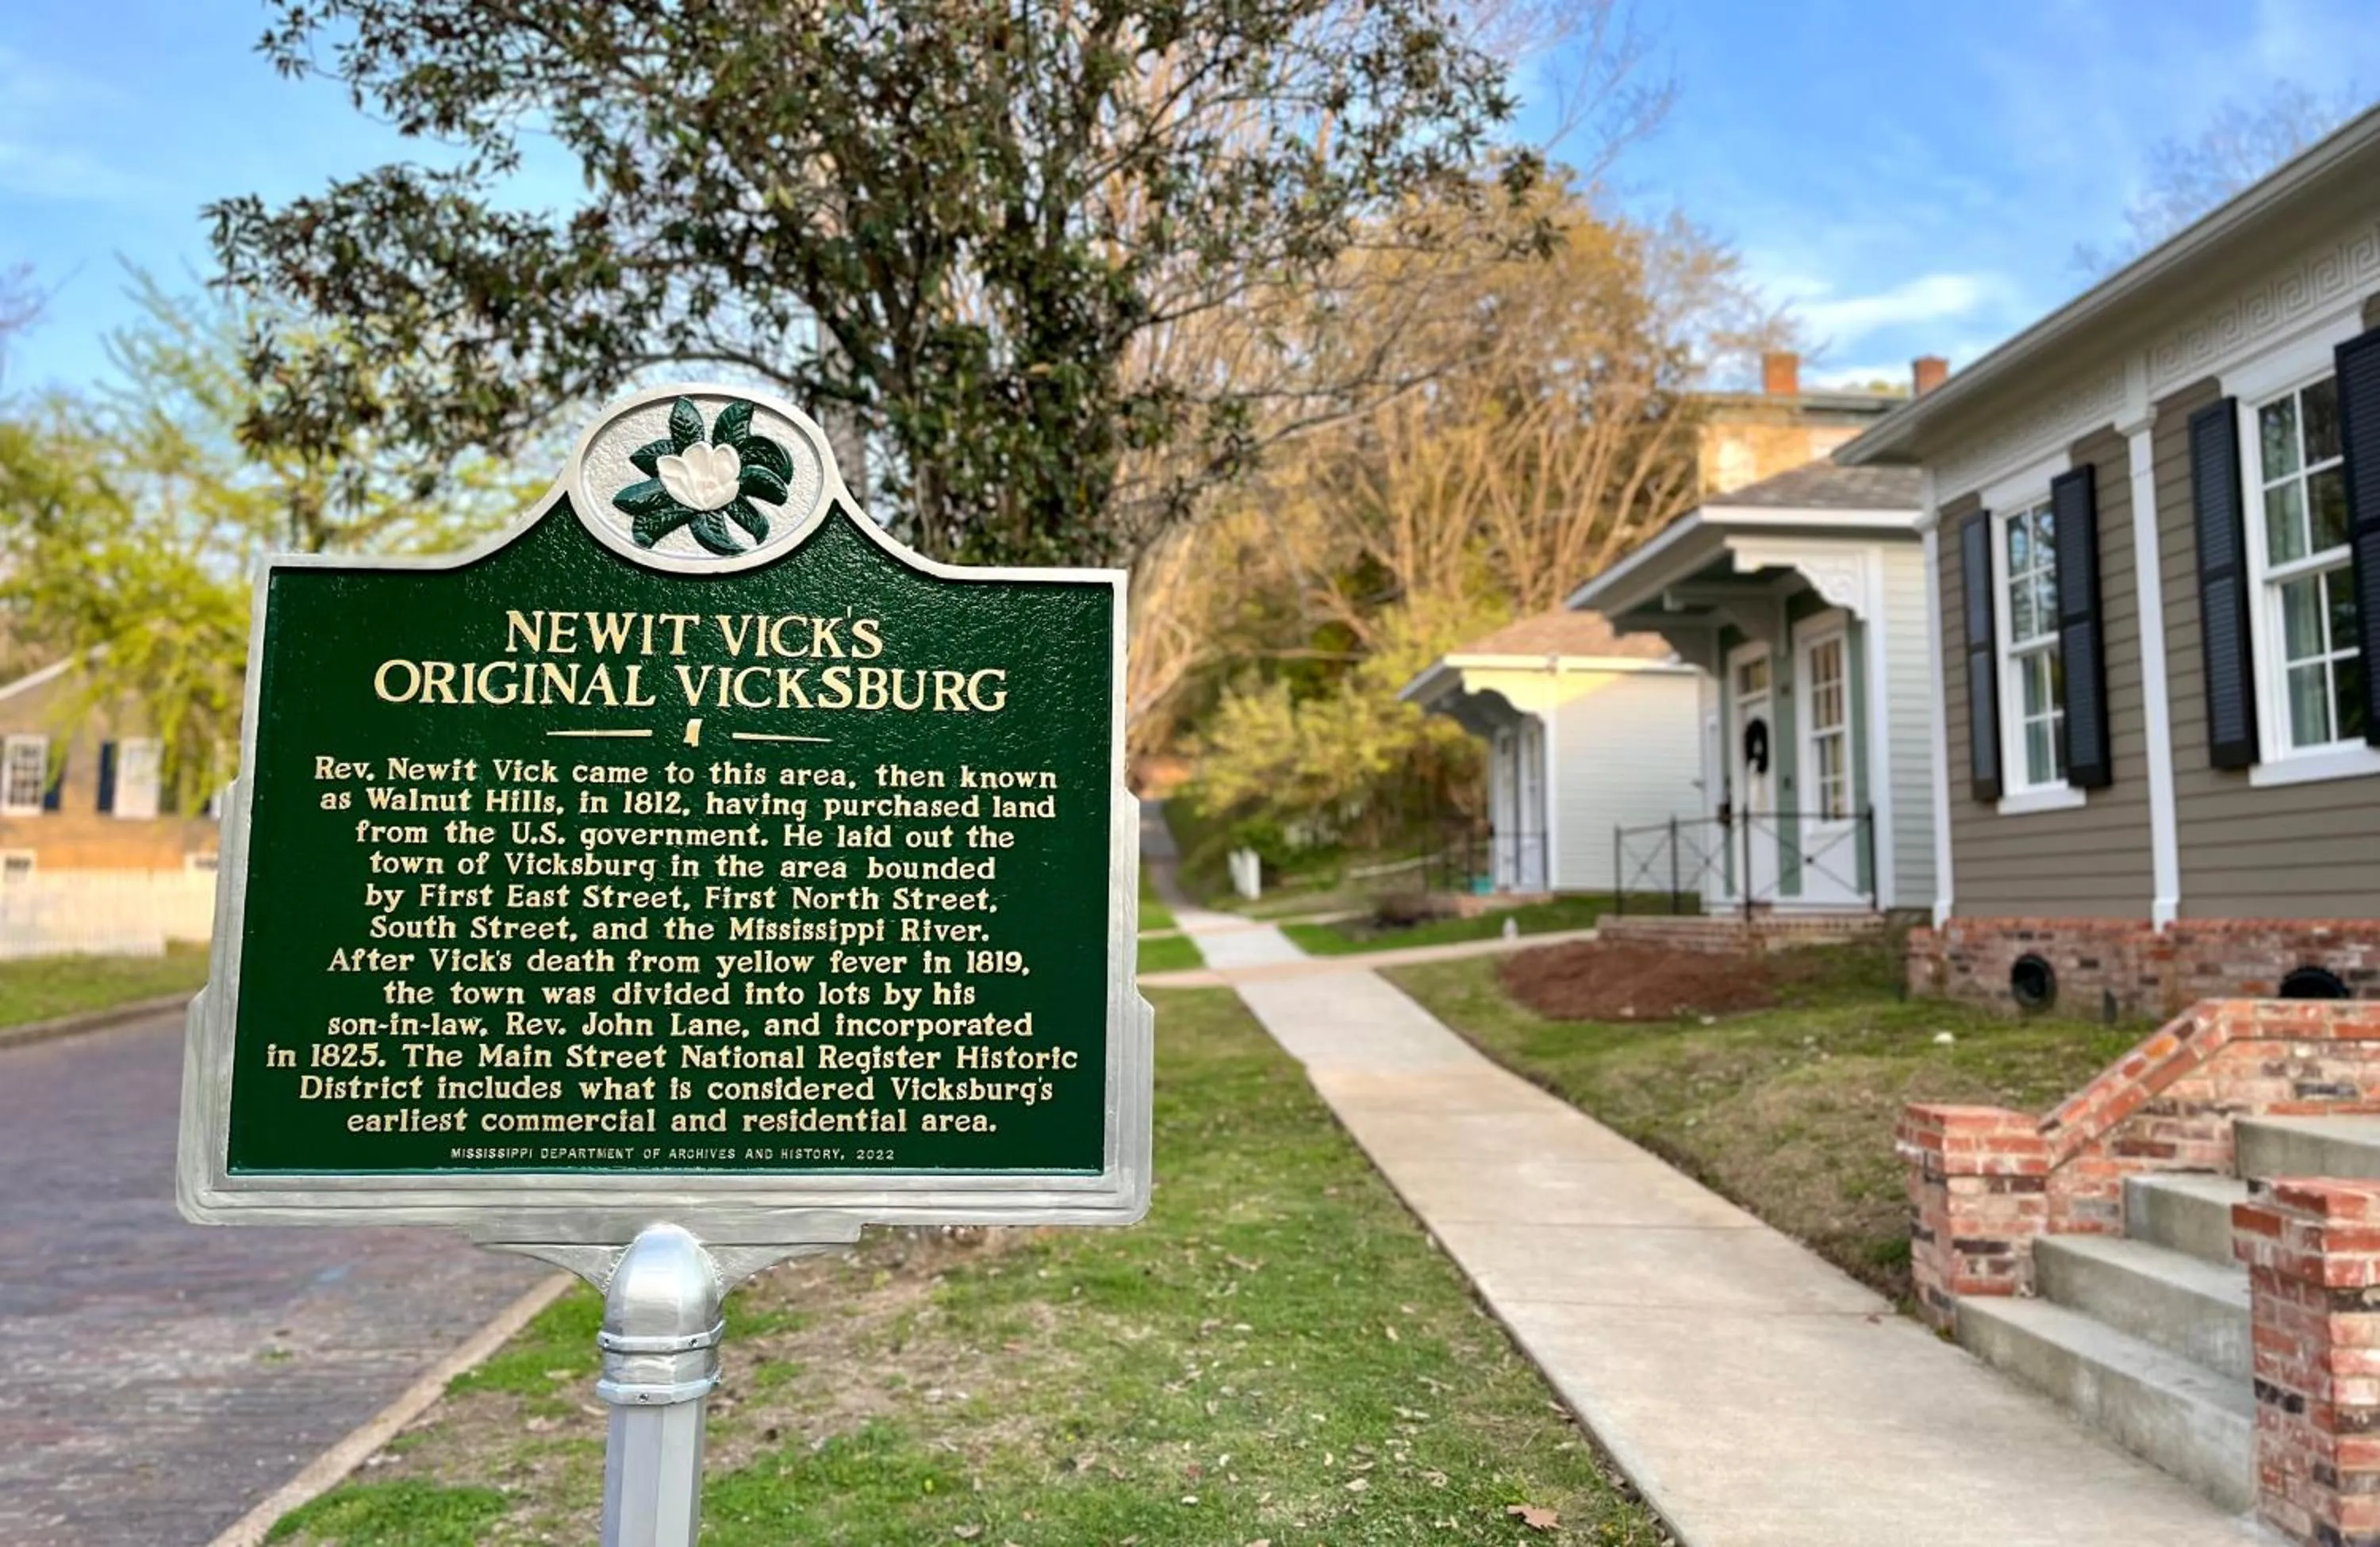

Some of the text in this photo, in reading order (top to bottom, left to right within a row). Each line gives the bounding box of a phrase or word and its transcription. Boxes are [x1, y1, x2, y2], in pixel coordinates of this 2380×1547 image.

[505, 605, 883, 658] NEWIT VICK'S
[374, 659, 1008, 712] ORIGINAL VICKSBURG
[315, 756, 1057, 789] Rev. Newit Vick came to this area, then known
[321, 787, 1056, 822] as Walnut Hills, in 1812, having purchased land
[355, 820, 1014, 850] from the U.S. government. He laid out the
[370, 850, 995, 881] town of Vicksburg in the area bounded
[365, 883, 996, 912] by First East Street, First North Street,
[370, 916, 988, 946] South Street, and the Mississippi River.
[328, 948, 1029, 979] After Vick's death from yellow fever in 1819,
[384, 981, 975, 1011] the town was divided into lots by his
[328, 1012, 1033, 1042] son-in-law, Rev. John Lane, and incorporated
[267, 1042, 1077, 1074] in 1825. The Main Street National Register Historic
[300, 1076, 1052, 1106] District includes what is considered Vicksburg's
[347, 1107, 996, 1131] earliest commercial and residential area.
[451, 1147, 894, 1161] MISSISSIPPI DEPARTMENT OF ARCHIVES AND HISTORY, 2022
